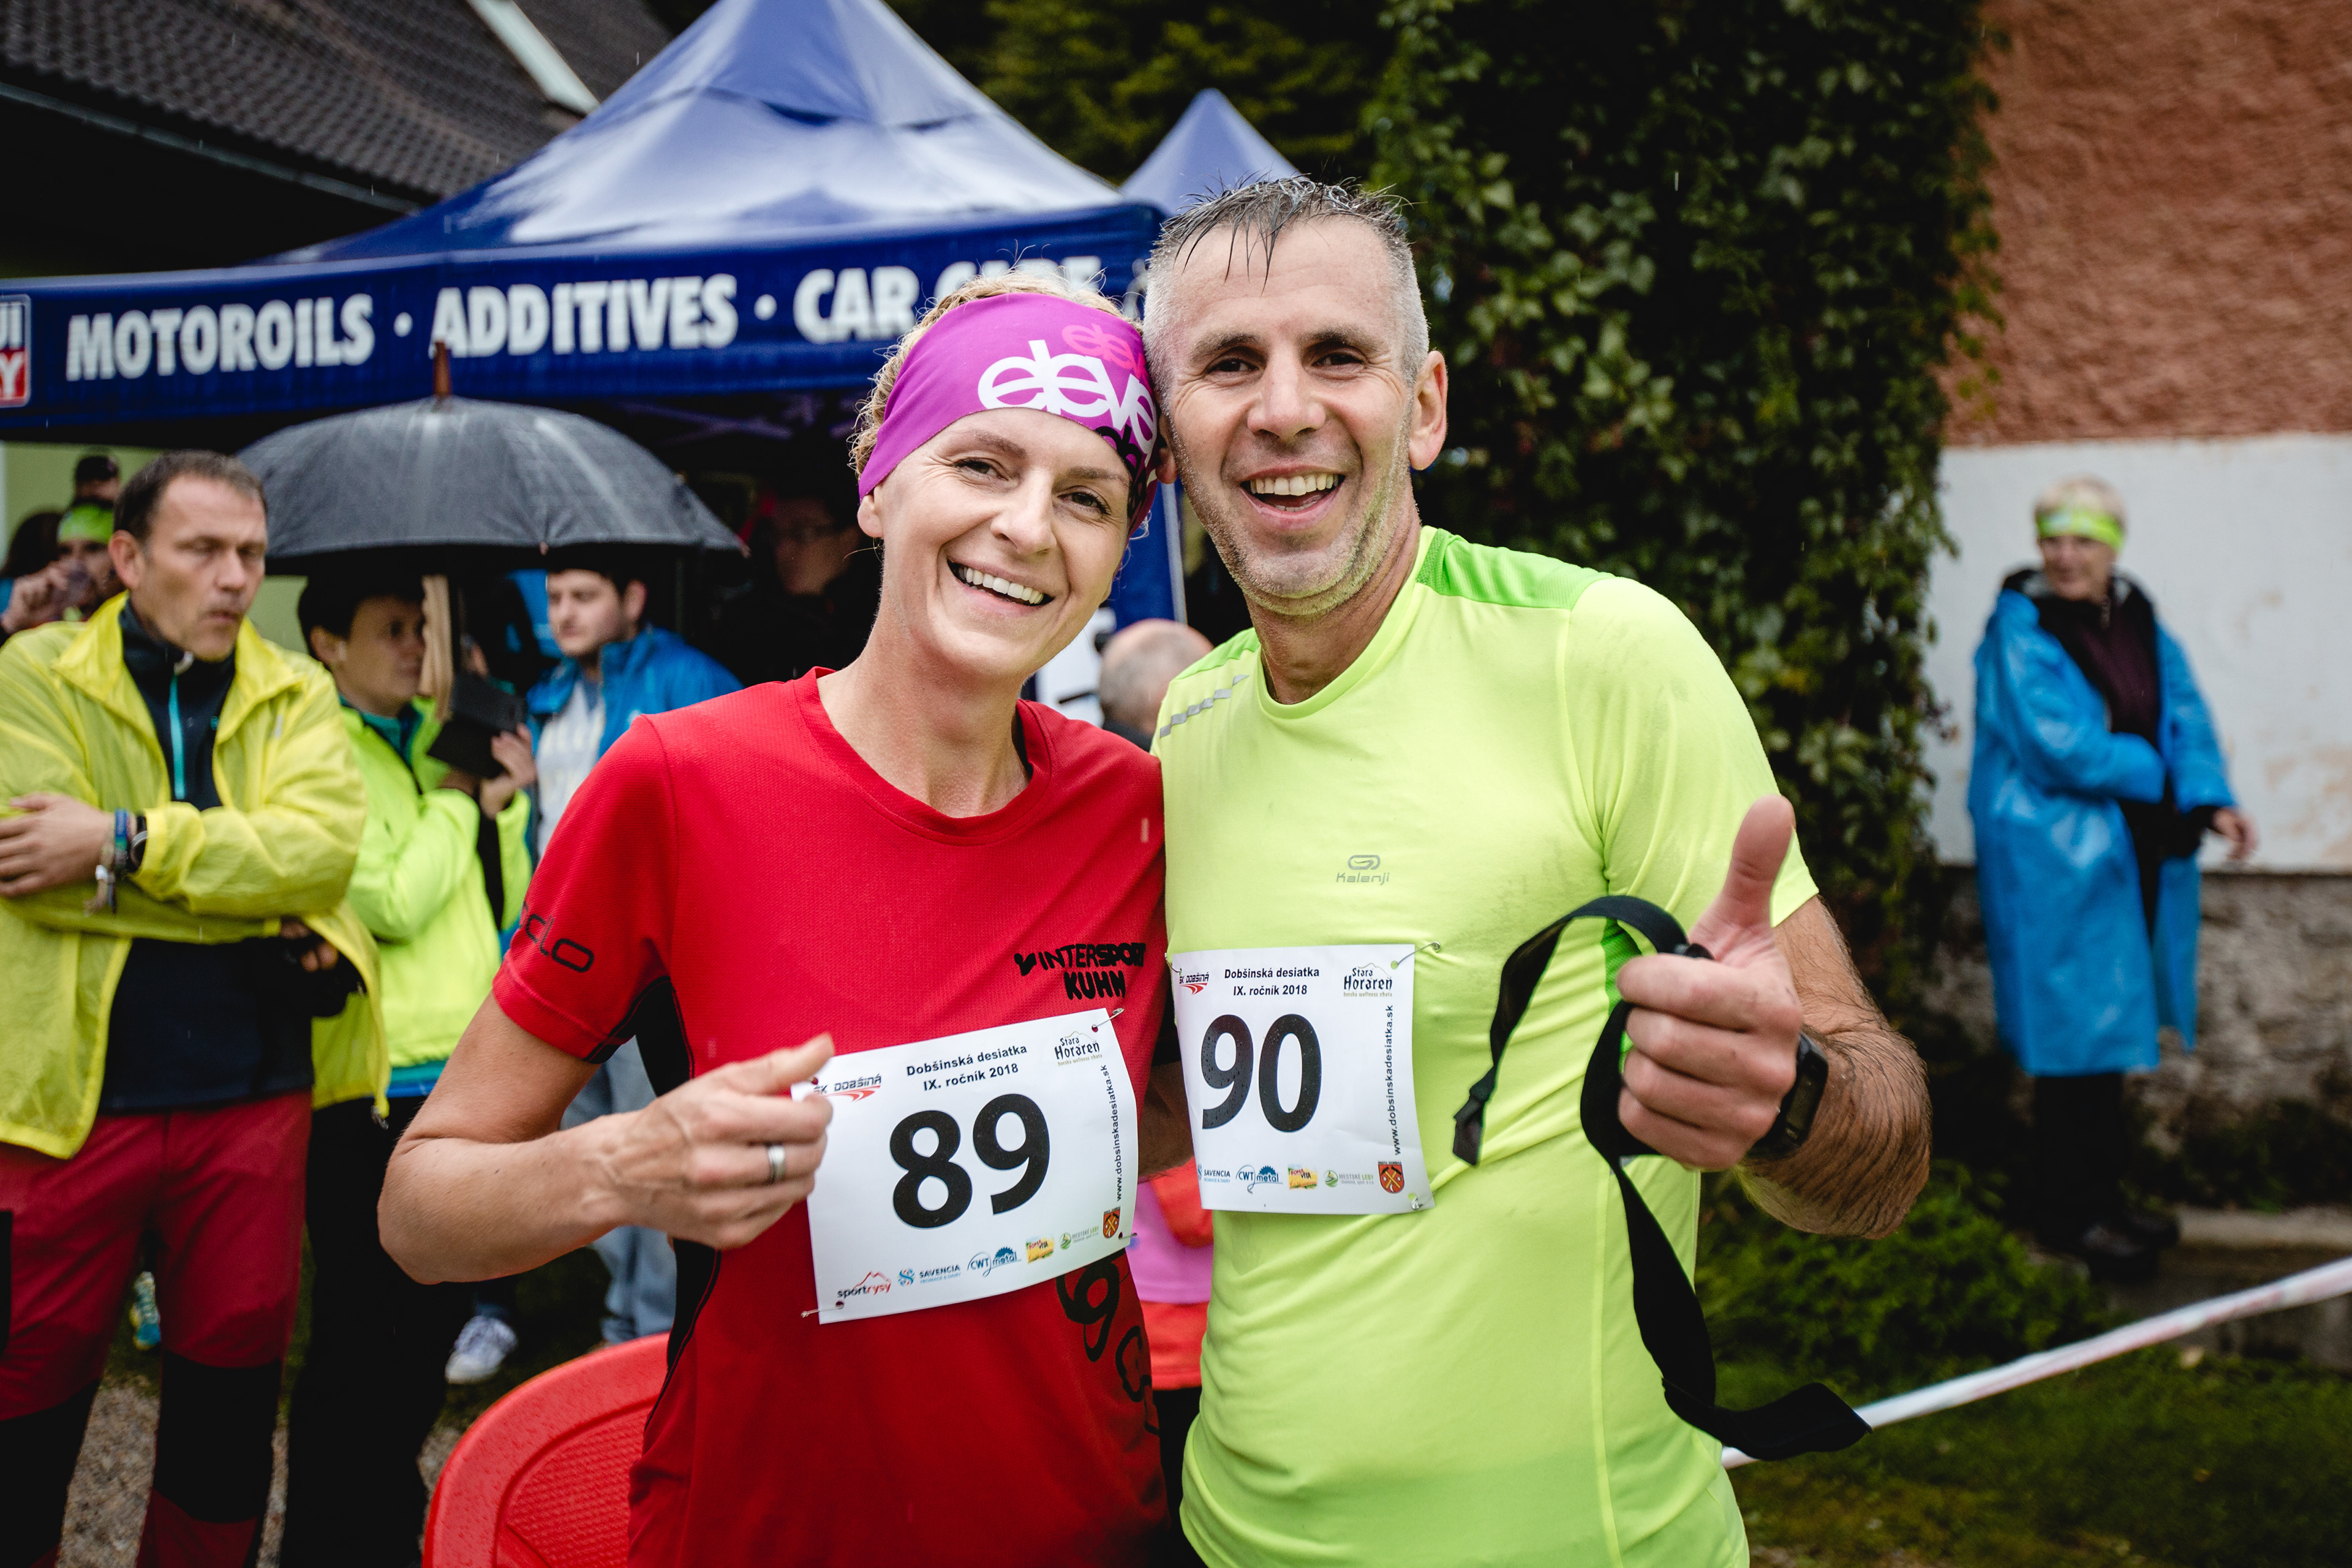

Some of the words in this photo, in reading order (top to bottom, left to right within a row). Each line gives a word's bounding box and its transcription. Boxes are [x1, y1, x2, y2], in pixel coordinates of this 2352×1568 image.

[66, 293, 375, 382] MOTOROILS
[428, 273, 739, 360] ADDITIVES
[793, 266, 919, 344] CAR
[1336, 872, 1390, 886] Kalenji
[1064, 970, 1126, 1000] KUHN
[1224, 968, 1273, 979] Dobšinská
[1276, 967, 1319, 978] desiatka
[1234, 986, 1246, 996] IX.
[1250, 985, 1280, 995] ročník
[1283, 984, 1308, 995] 2018
[907, 1054, 973, 1076] Dobšinská
[978, 1046, 1027, 1062] desiatka
[1200, 1014, 1322, 1133] 90
[924, 1079, 941, 1091] IX.
[946, 1070, 986, 1087] ročník
[989, 1063, 1019, 1078] 2018
[1385, 1005, 1401, 1156] www.dobsinskadesiatka.sk
[1101, 1065, 1122, 1202] www.dobsinskadesiatka.sk
[890, 1093, 1050, 1229] 89
[1238, 1171, 1254, 1181] CWT
[1256, 1173, 1279, 1183] metal
[919, 1264, 960, 1278] SAVENCIA
[970, 1258, 989, 1270] CWT
[992, 1251, 1017, 1266] metal
[837, 1283, 892, 1299] sportrysy
